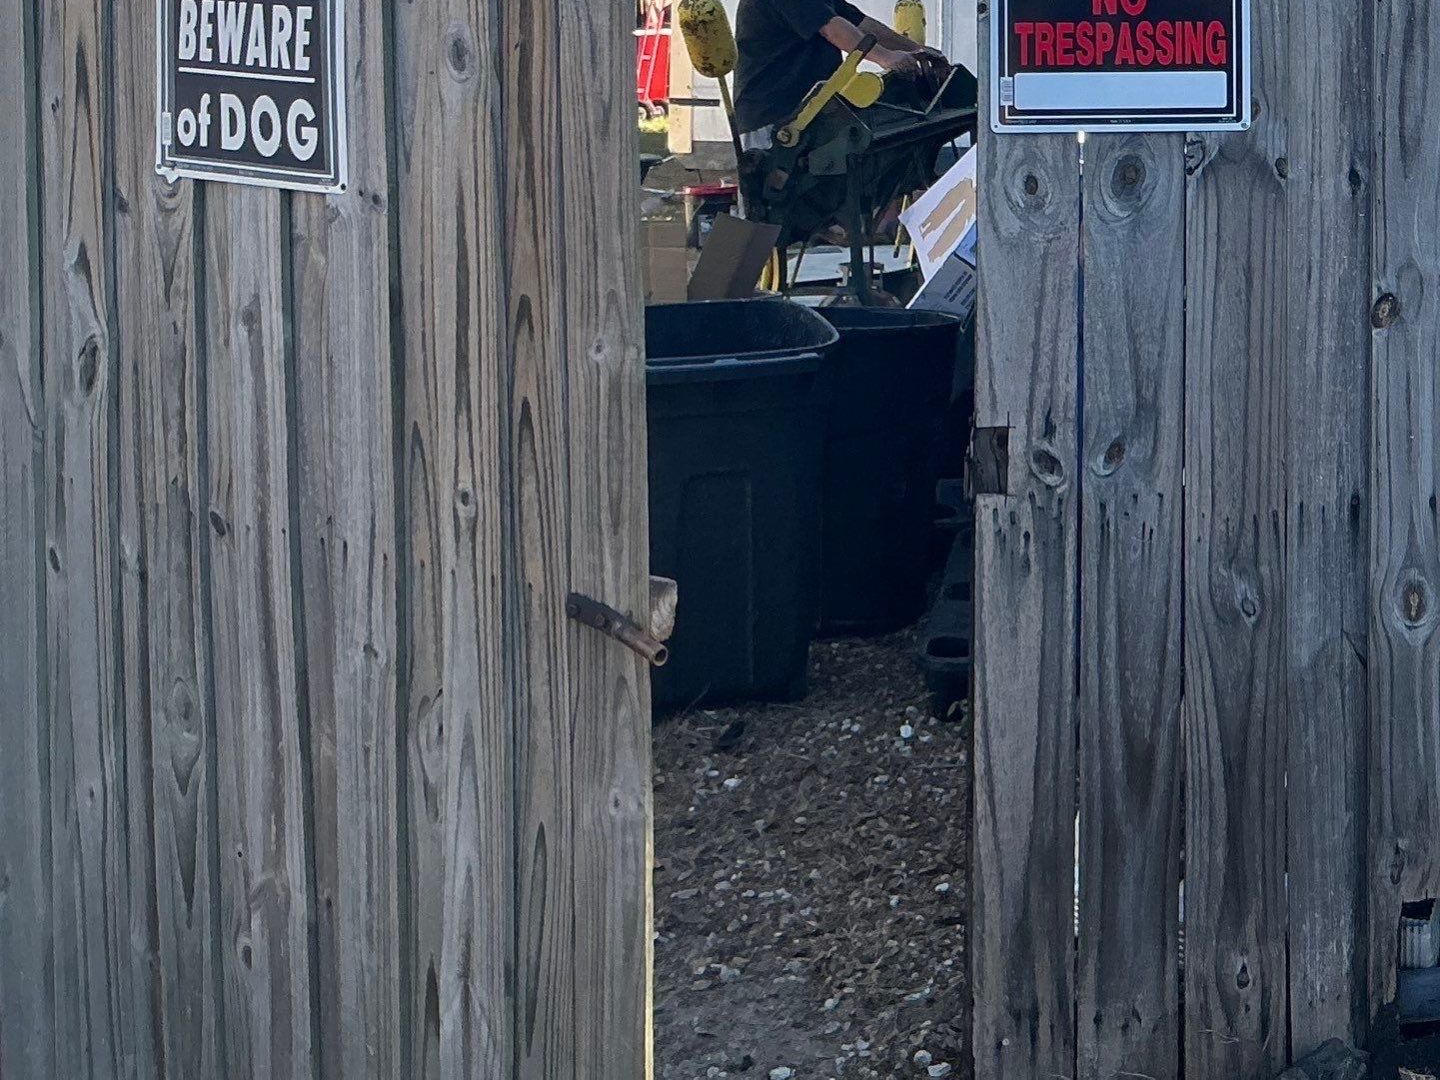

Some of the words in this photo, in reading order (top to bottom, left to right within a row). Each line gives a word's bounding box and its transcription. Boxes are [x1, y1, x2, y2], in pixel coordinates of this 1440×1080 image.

[1013, 20, 1227, 66] TRESPASSING
[177, 92, 211, 148] of
[220, 93, 318, 161] DOG
